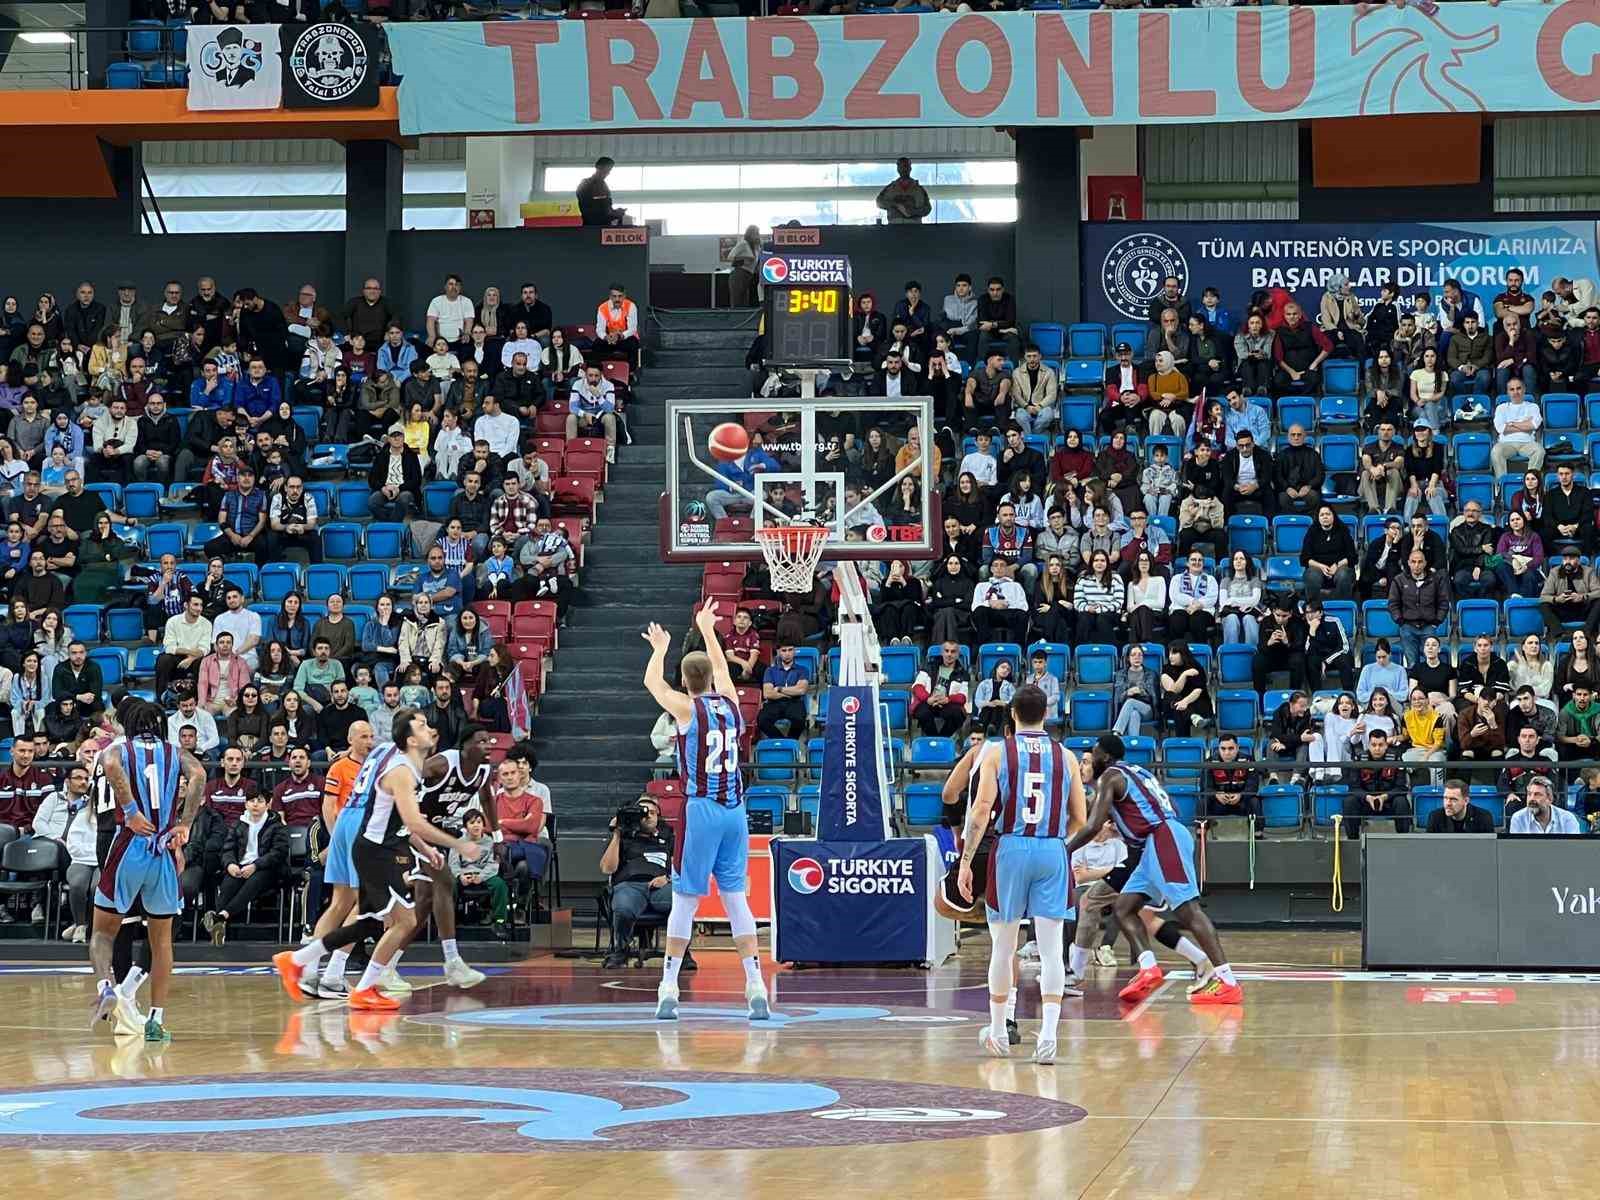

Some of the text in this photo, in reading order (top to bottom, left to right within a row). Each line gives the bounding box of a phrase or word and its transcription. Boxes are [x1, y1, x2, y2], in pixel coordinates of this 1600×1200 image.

[482, 7, 1315, 124] TRABZONLU
[1198, 236, 1588, 258] TÜM ANTRENÖR VE SPORCULARIMIZA
[788, 289, 837, 313] 3:40
[705, 728, 739, 773] 25
[143, 763, 160, 810] 1
[1022, 772, 1046, 824] 5
[828, 859, 913, 876] TÜRKİYE
[828, 877, 915, 894] SİGORTA
